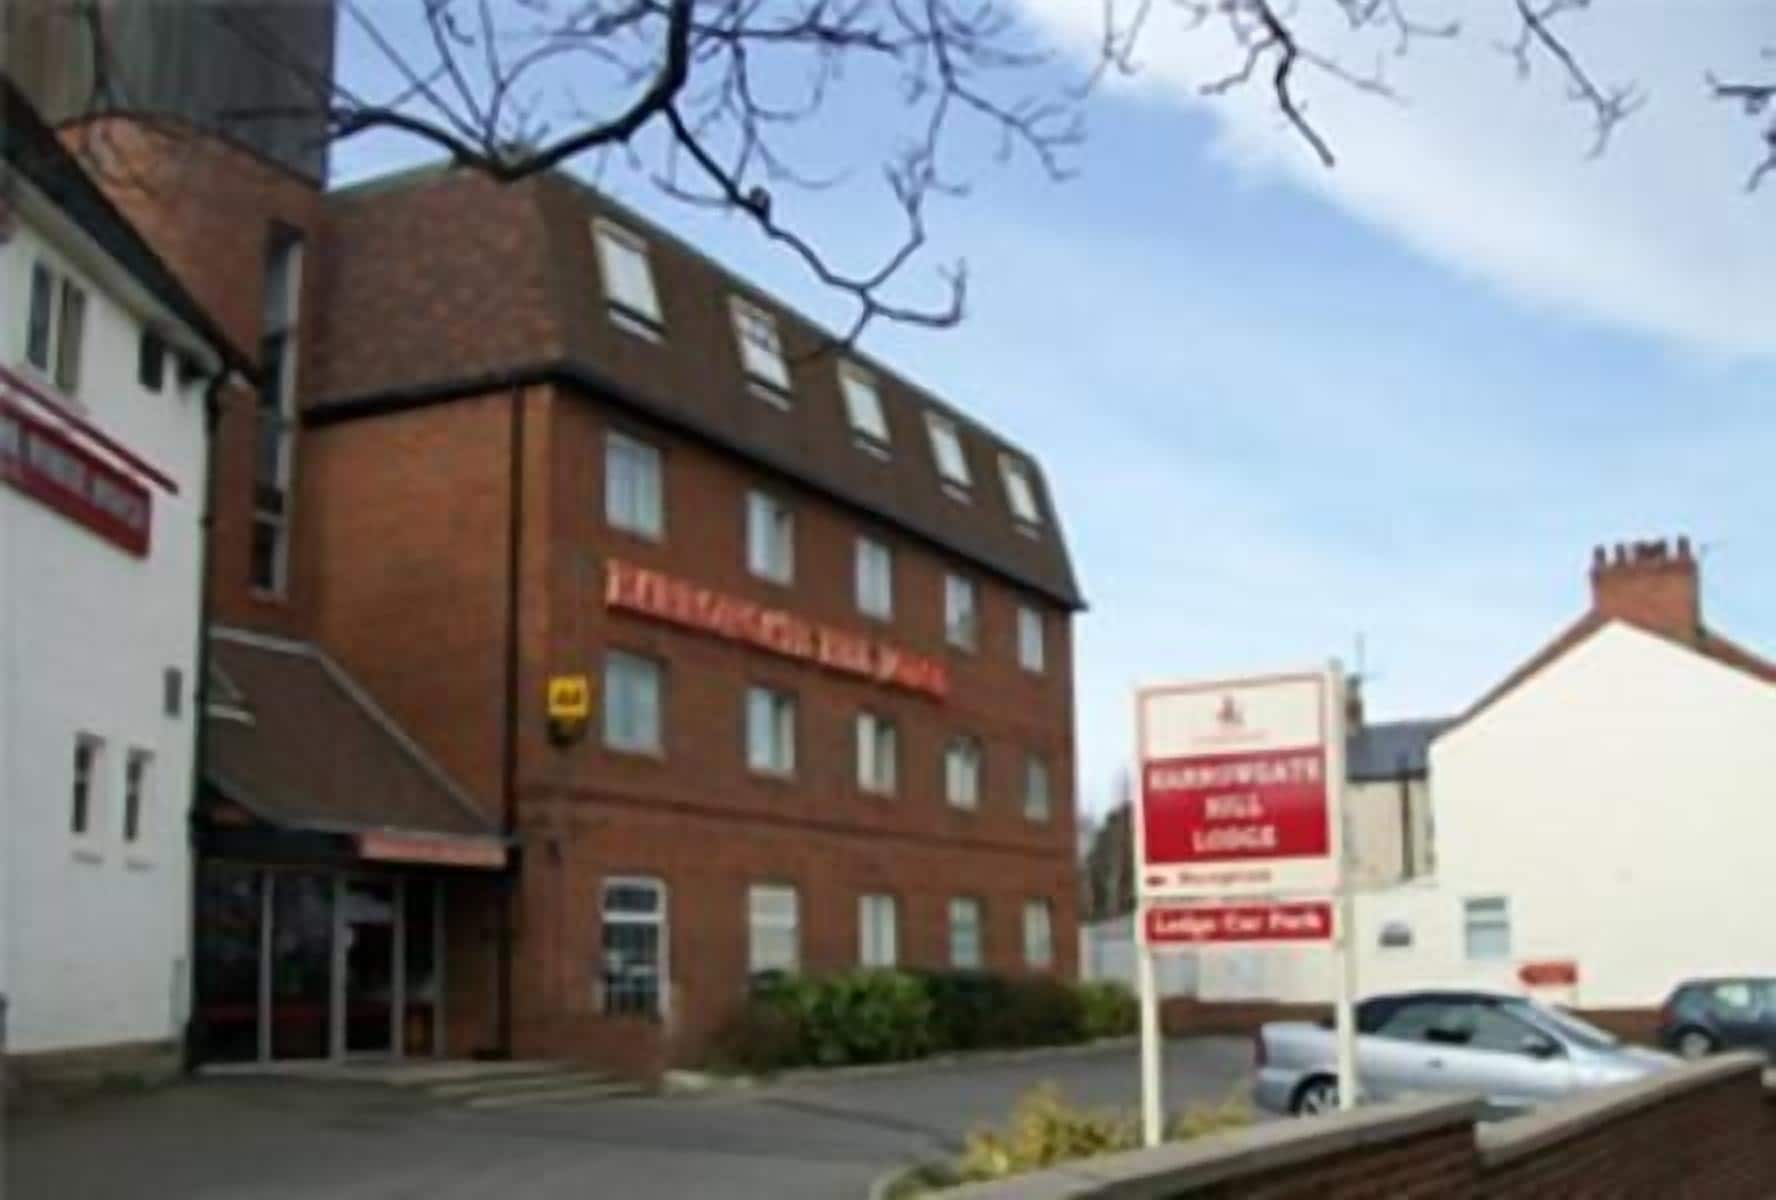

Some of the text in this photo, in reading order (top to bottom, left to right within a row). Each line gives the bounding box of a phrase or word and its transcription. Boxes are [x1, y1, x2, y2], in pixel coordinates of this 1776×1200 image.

[1192, 824, 1277, 852] LODGE
[1154, 911, 1217, 938] Lodge
[1268, 909, 1323, 930] Park
